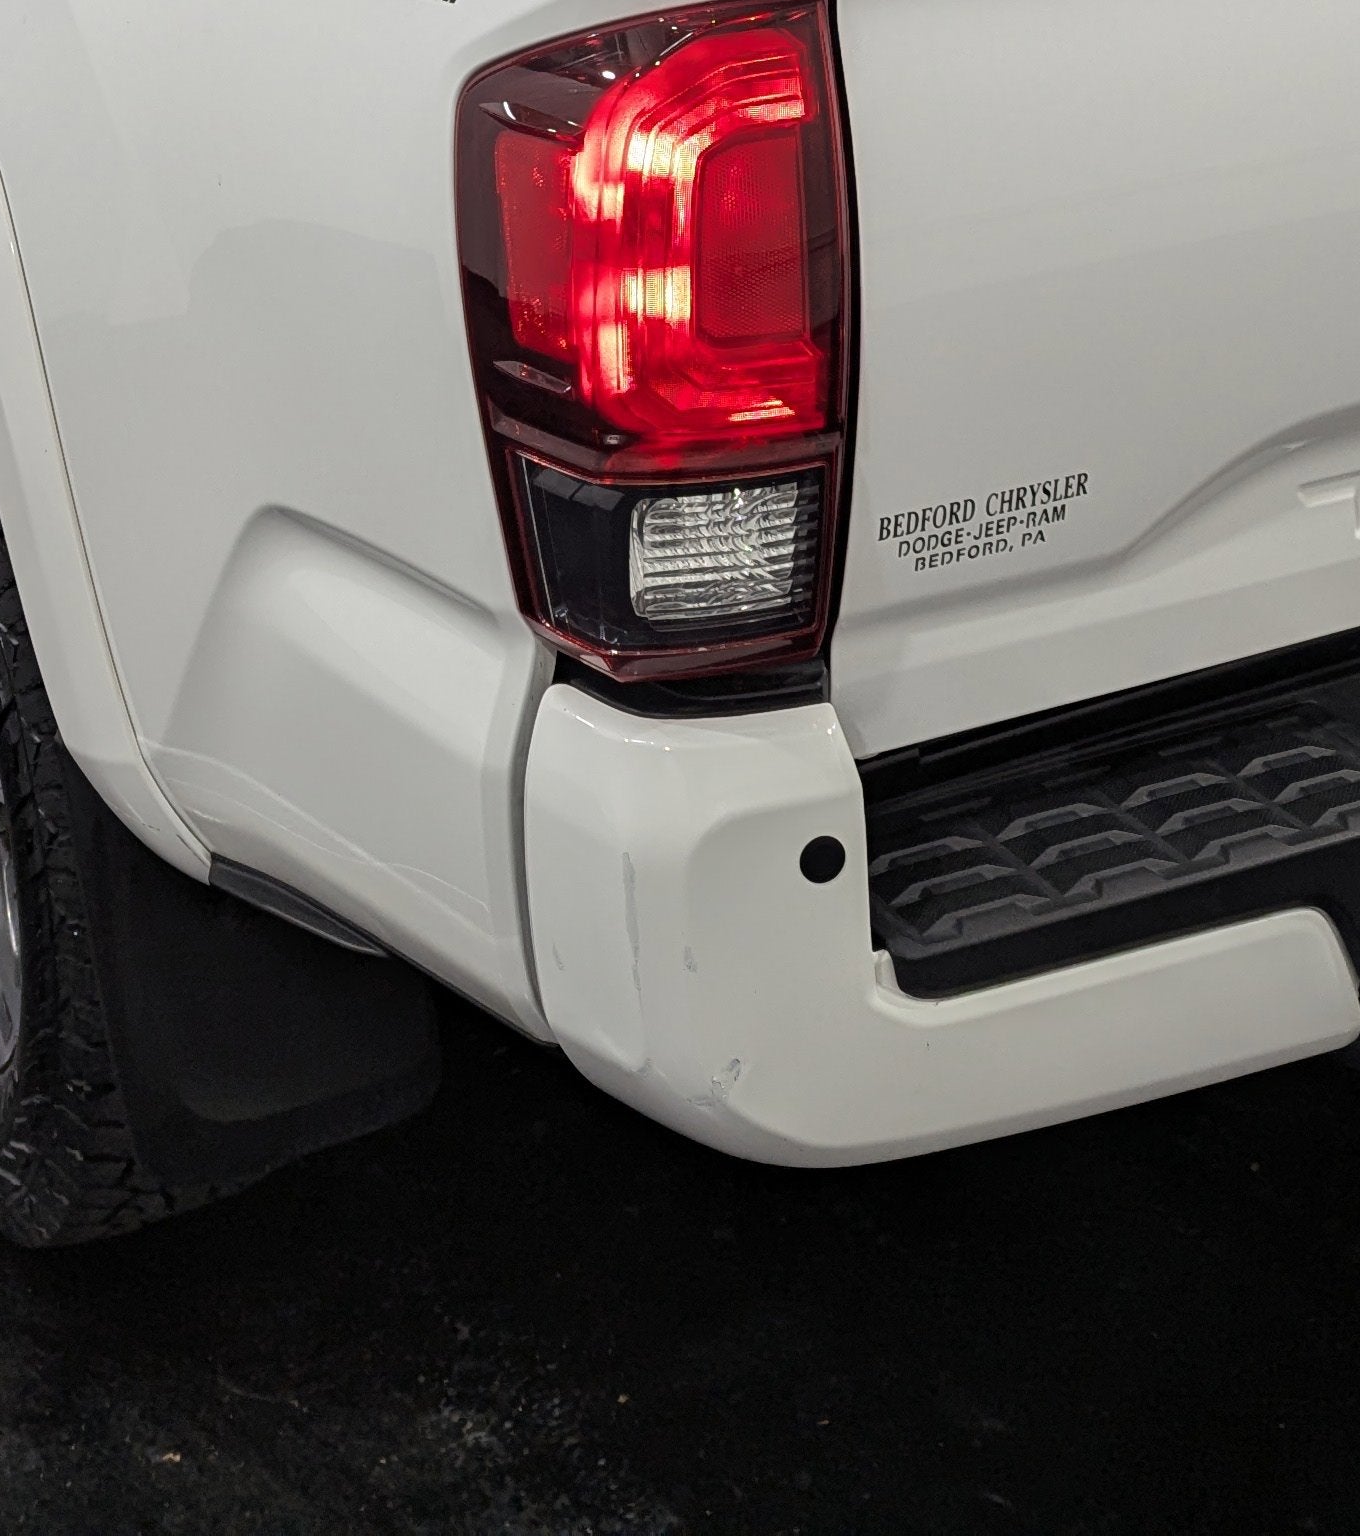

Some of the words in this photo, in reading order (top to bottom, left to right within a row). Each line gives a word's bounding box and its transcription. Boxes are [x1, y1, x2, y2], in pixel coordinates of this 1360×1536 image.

[878, 498, 977, 541] BEDFORD
[985, 472, 1088, 517] CHRYSLER
[913, 538, 1015, 572] BEDFORD,
[1020, 529, 1047, 548] PA
